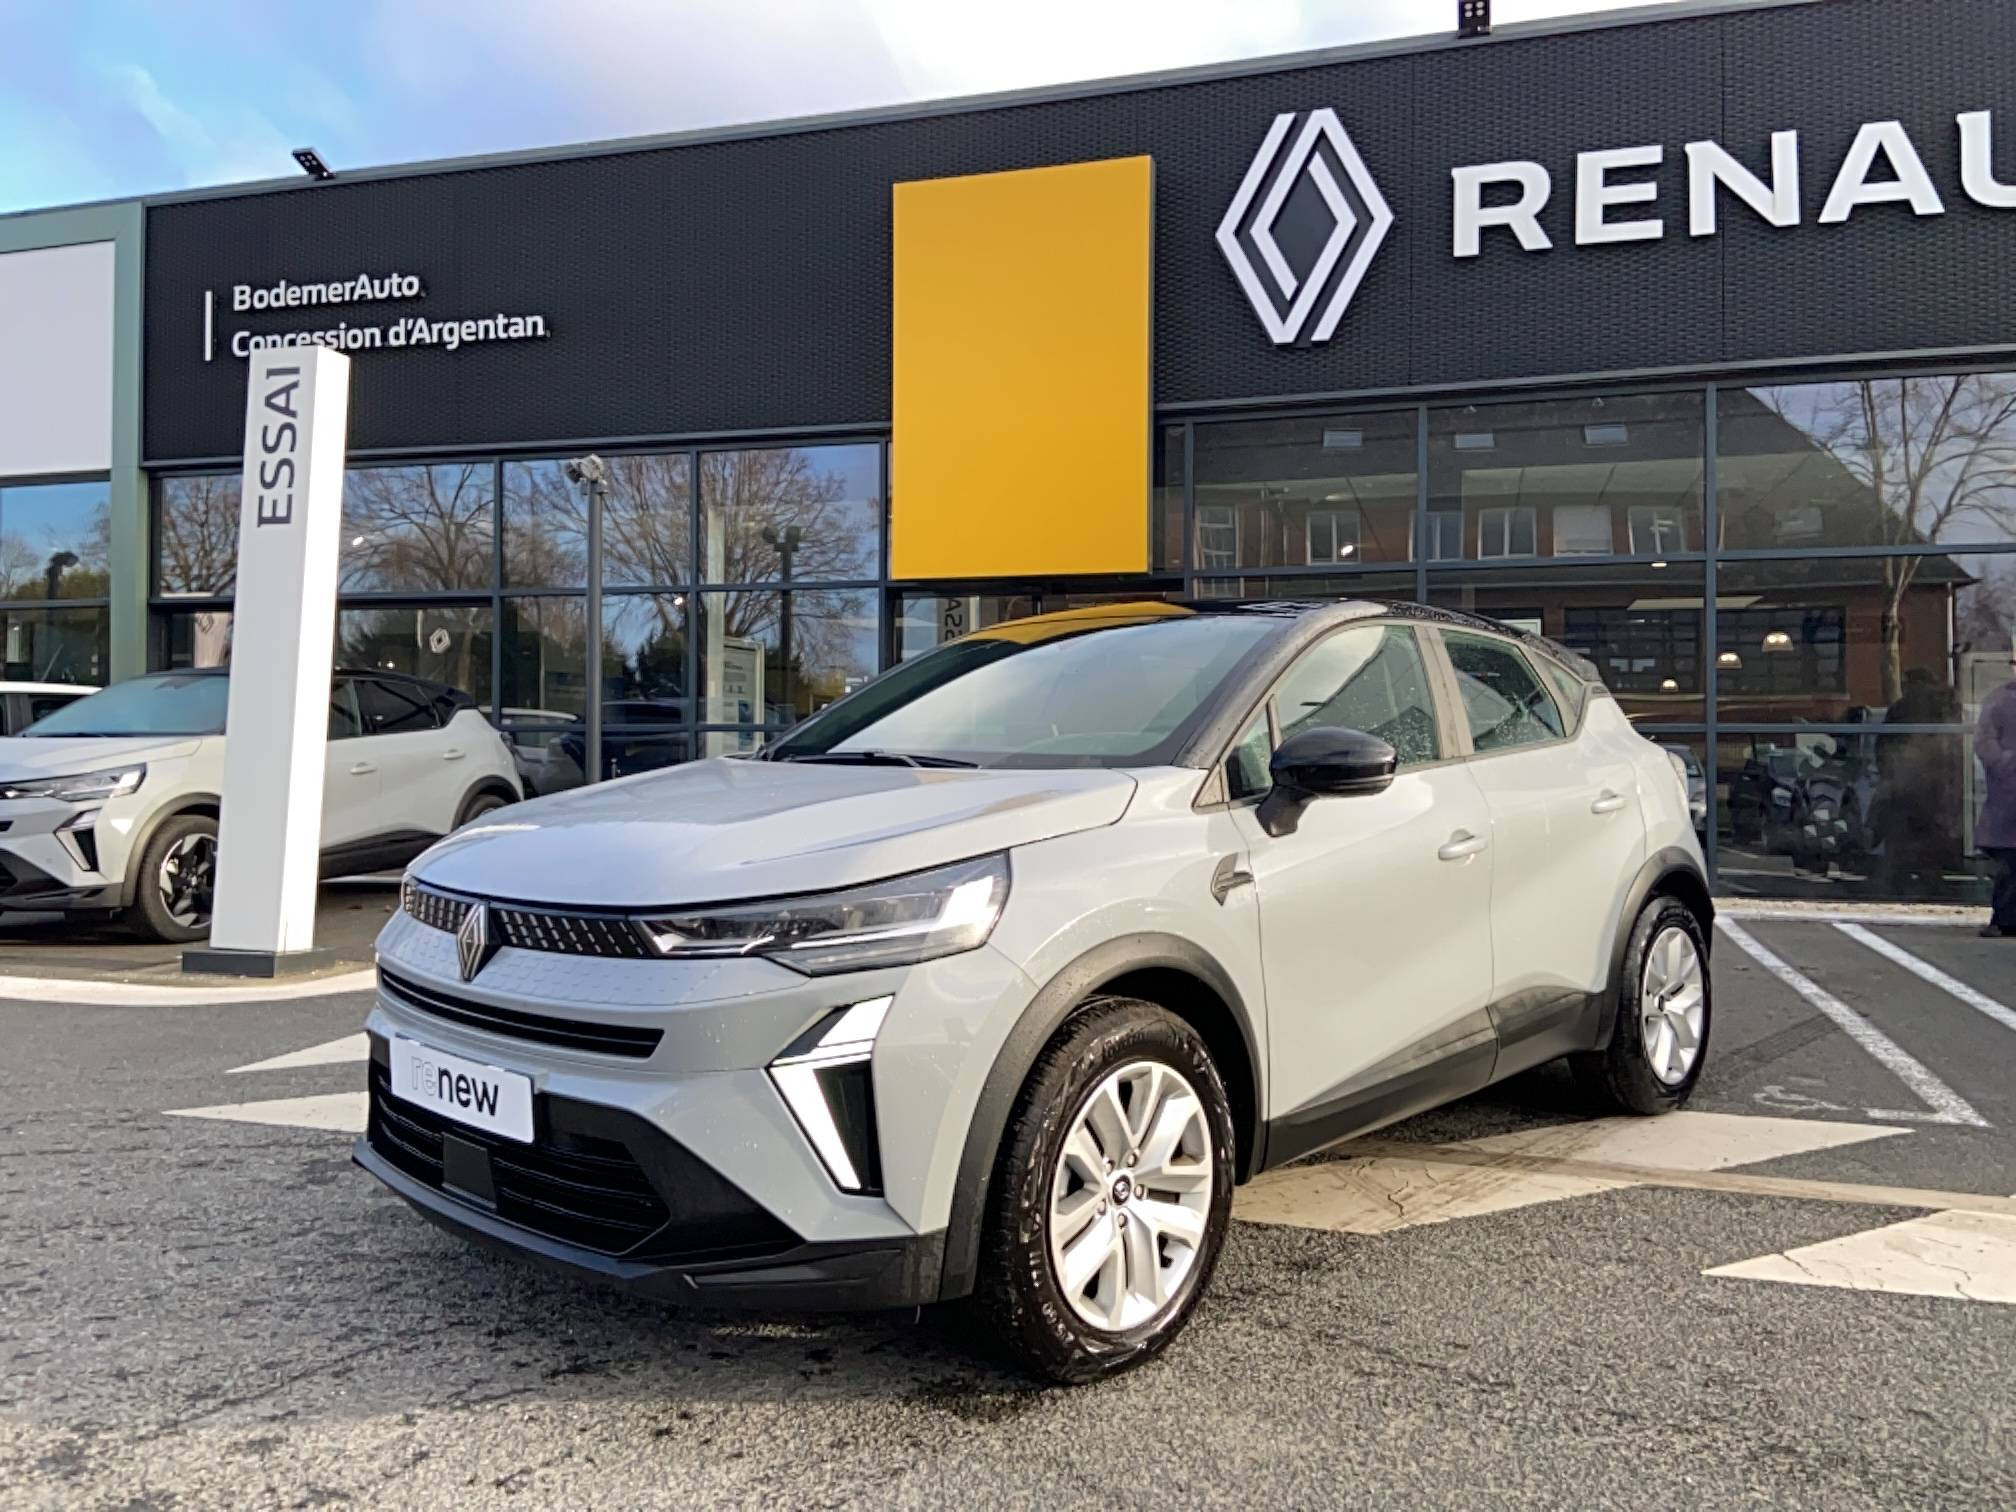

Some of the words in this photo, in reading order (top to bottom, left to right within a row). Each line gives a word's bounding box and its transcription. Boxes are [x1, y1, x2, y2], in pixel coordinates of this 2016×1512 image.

[1451, 110, 2016, 258] RENAU
[232, 272, 420, 311] BodemerAuto
[388, 313, 545, 351] d'Argentan
[257, 365, 301, 528] ESSAI
[411, 1056, 499, 1117] renew
